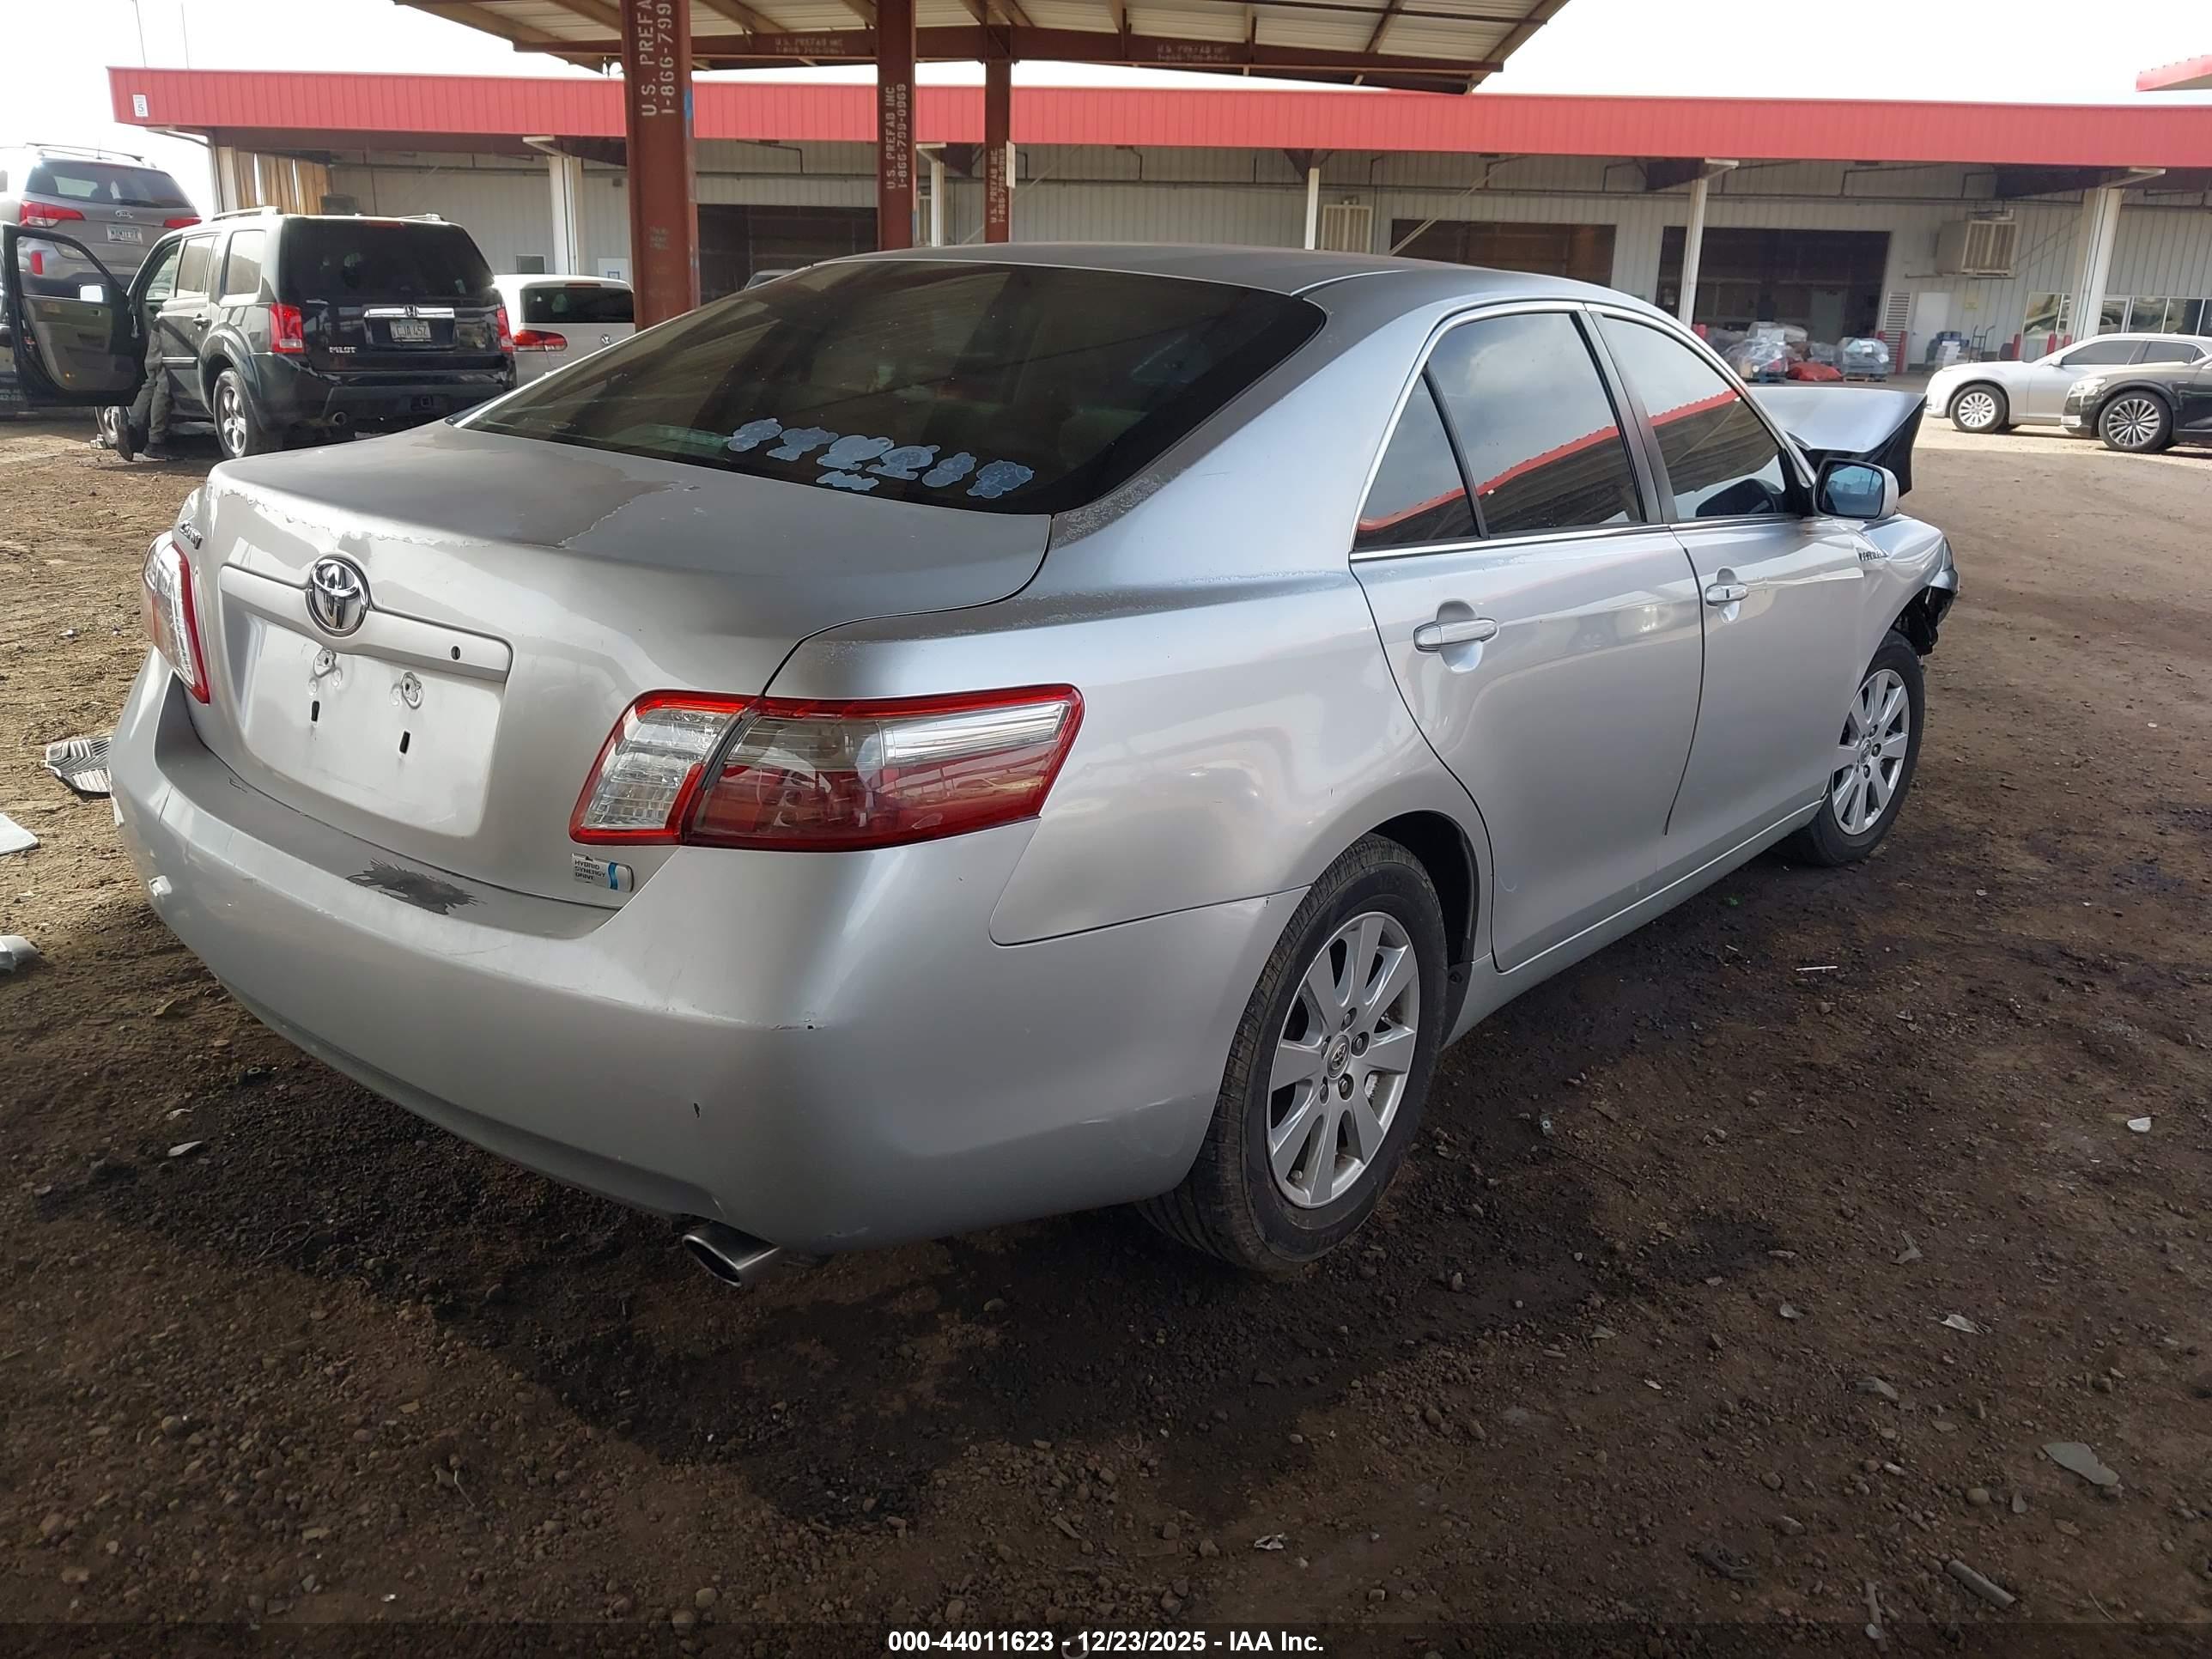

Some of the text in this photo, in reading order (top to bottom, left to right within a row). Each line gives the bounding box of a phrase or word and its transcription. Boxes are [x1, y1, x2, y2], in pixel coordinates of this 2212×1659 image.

[641, 77, 657, 117] U.S.
[137, 103, 144, 112] 5
[885, 112, 896, 160] PREFAB
[574, 860, 600, 870] HYBRID
[574, 866, 606, 878] SYNERGY
[574, 872, 594, 880] DRIVE
